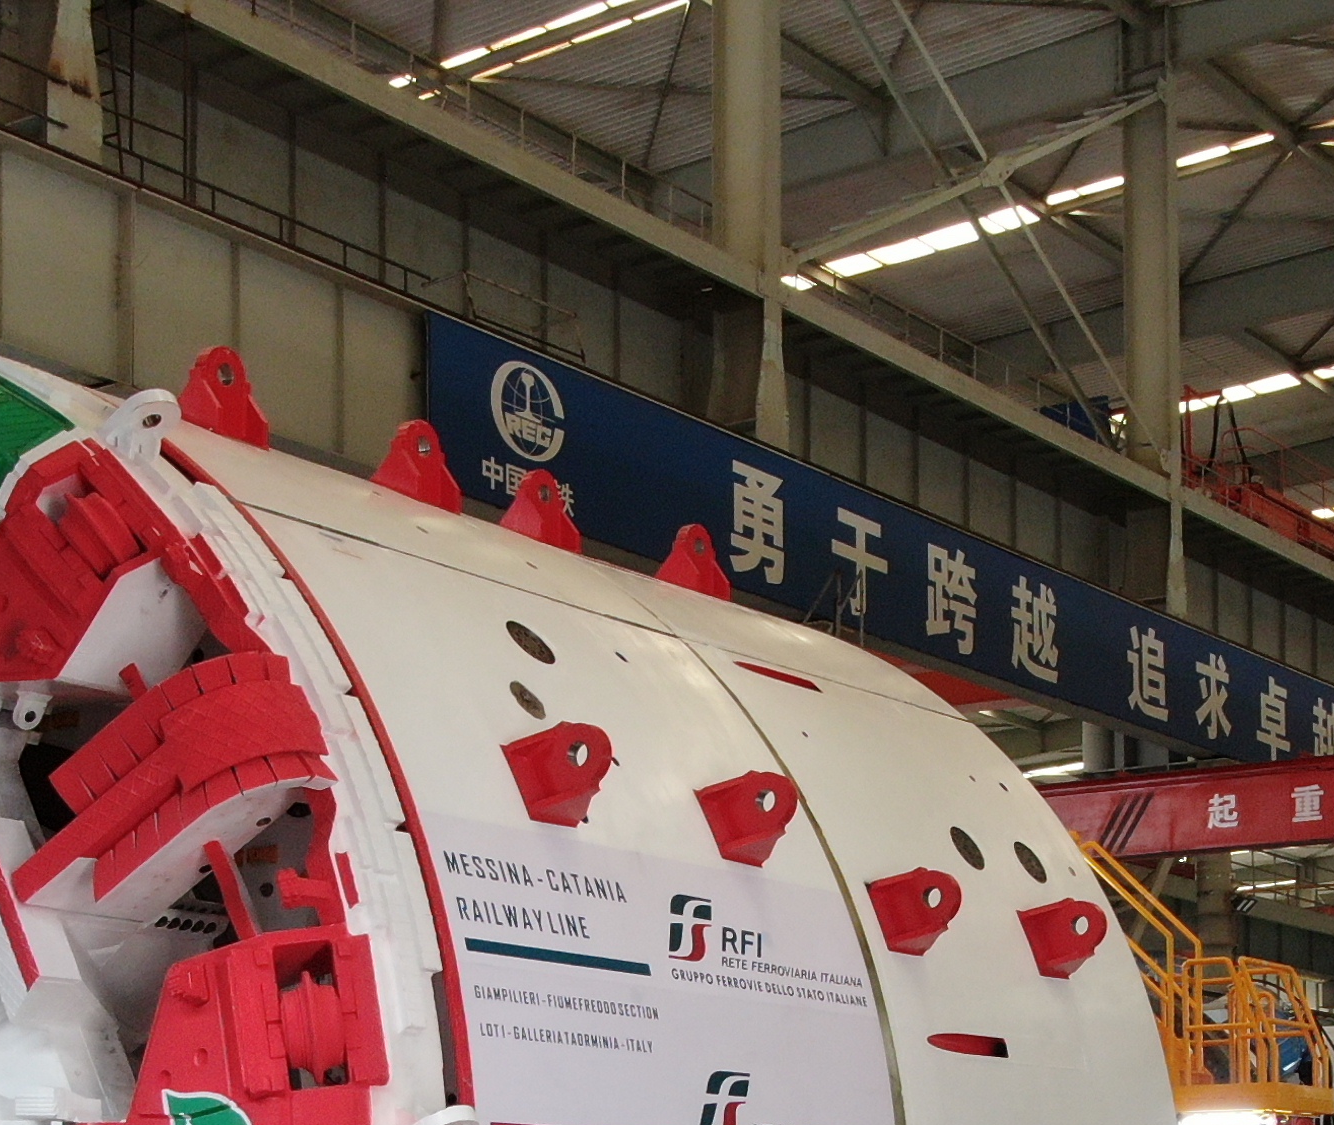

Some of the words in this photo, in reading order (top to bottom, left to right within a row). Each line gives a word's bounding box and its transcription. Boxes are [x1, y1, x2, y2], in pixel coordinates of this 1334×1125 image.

[481, 456, 574, 517] 中国铁
[731, 458, 1059, 684] 勇于跨越
[456, 896, 544, 932] RAILWAY
[546, 911, 591, 940] LINE
[721, 926, 762, 958] RFI
[671, 968, 714, 985] GRUPPO
[716, 975, 763, 993] FERROVIE
[765, 982, 795, 997] DELLO
[796, 987, 825, 1001] STATO
[826, 992, 868, 1008] ITALIANE
[721, 957, 748, 971] RETE
[751, 961, 817, 982] FERROVIARIA
[820, 972, 863, 988] ITALIANA
[479, 1022, 499, 1038] LOT
[618, 1003, 659, 1021] SECTION
